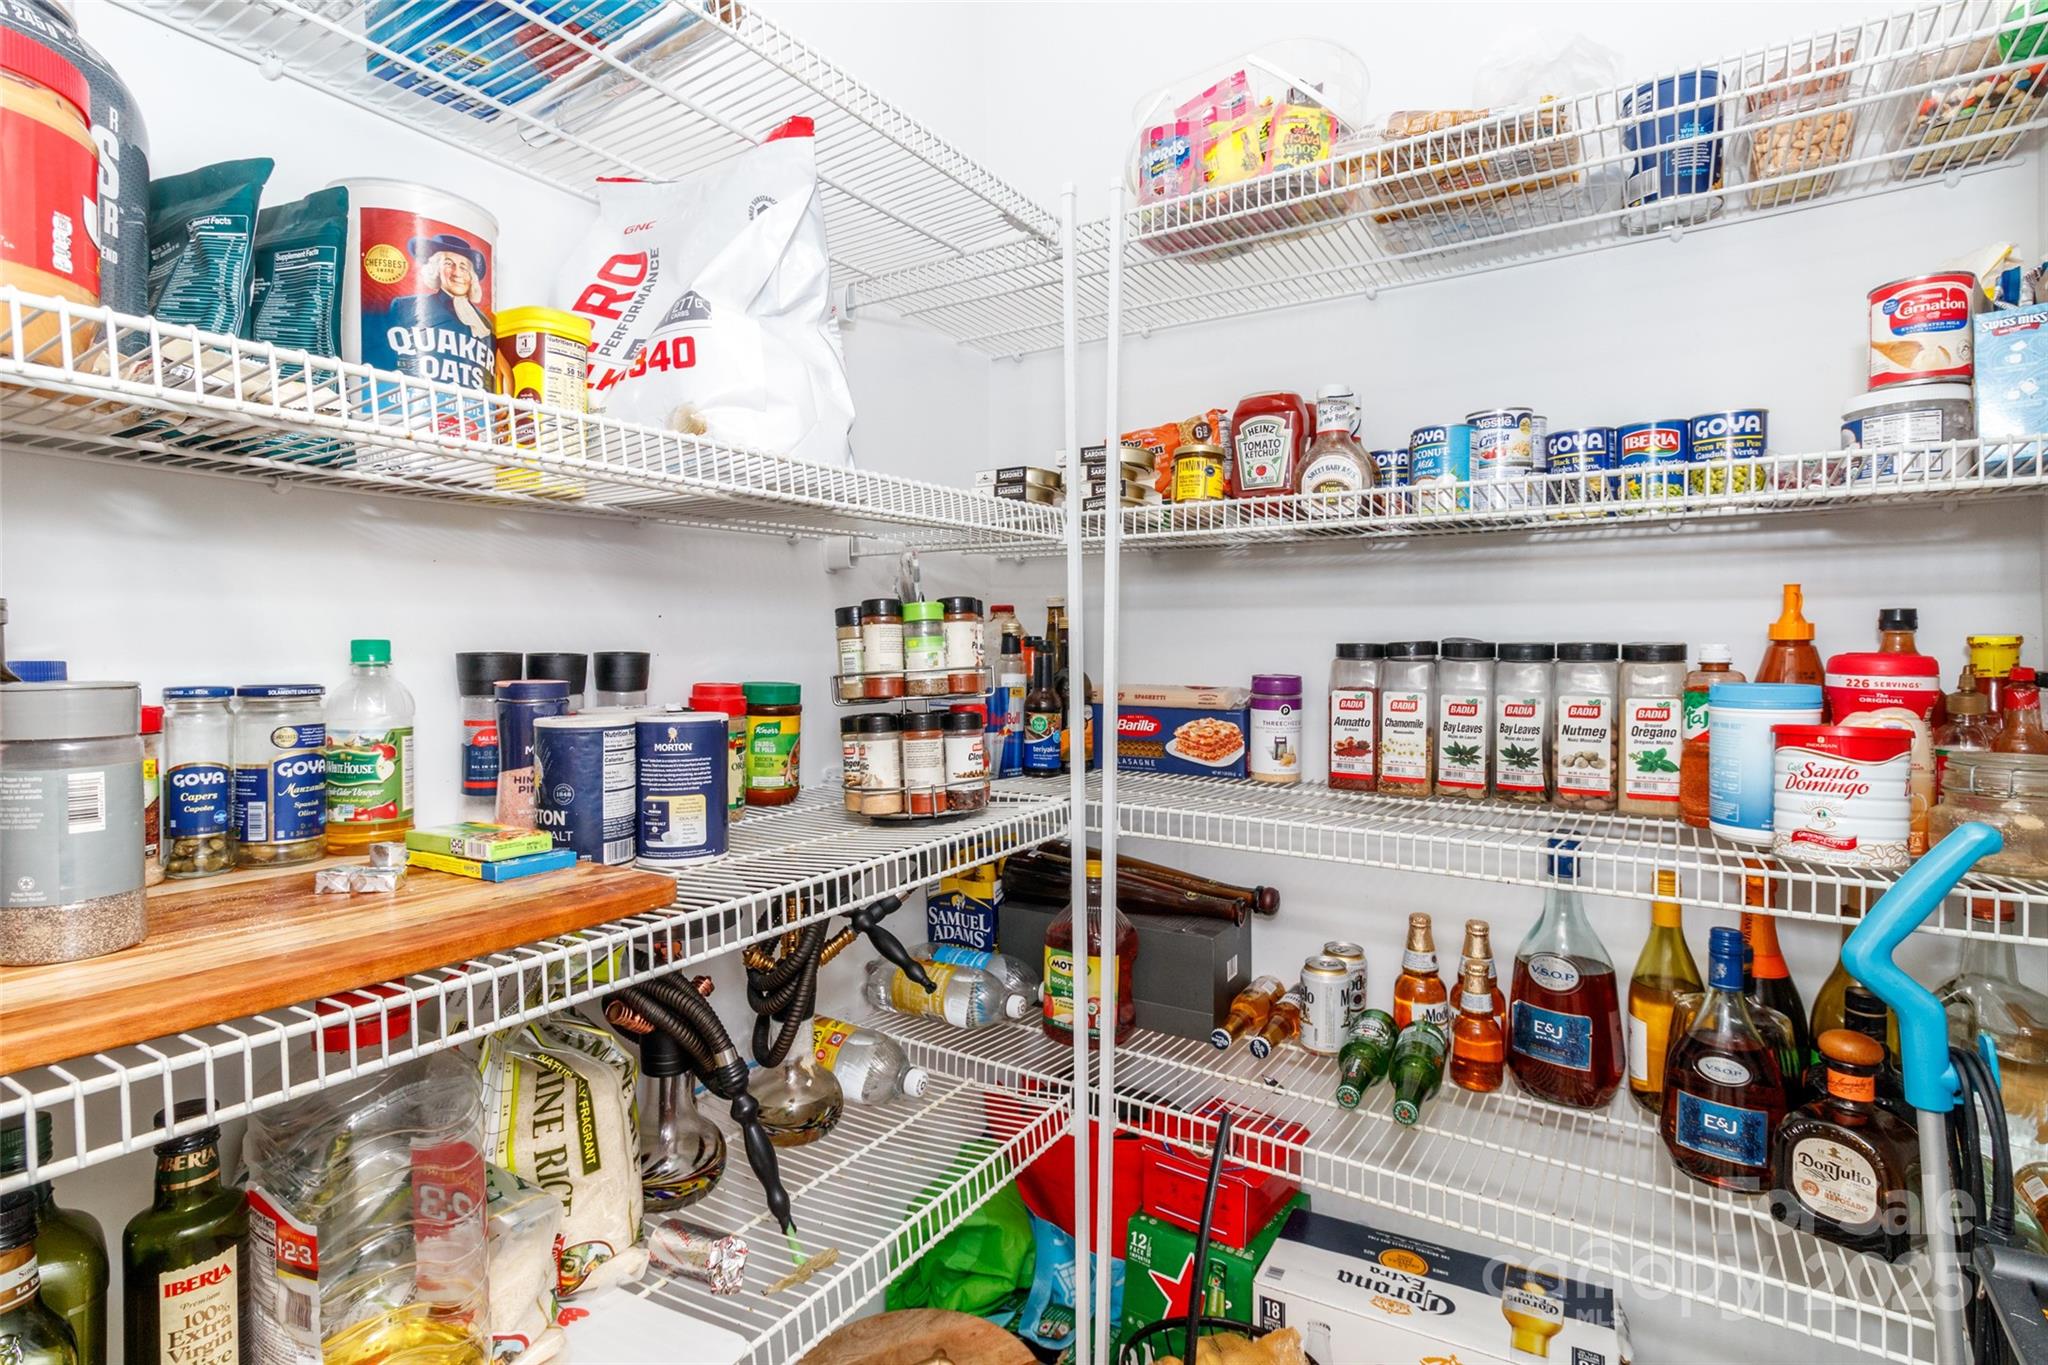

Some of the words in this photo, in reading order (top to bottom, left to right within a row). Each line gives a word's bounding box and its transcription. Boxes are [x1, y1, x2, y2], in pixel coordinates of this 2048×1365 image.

[1284, 134, 1320, 146] PATCH
[624, 220, 657, 235] GNC
[365, 257, 407, 270] CHEFSBEST
[599, 247, 661, 358] PERFORMANCE
[1894, 298, 1968, 320] Carnation
[386, 325, 497, 378] QUAKER
[421, 354, 486, 390] OATS
[1247, 424, 1276, 437] HEINZ
[1694, 414, 1762, 439] GOYA
[1243, 438, 1281, 451] TOMATO
[1411, 428, 1446, 447] GOYA
[1548, 432, 1604, 456] GOYA
[1623, 433, 1679, 450] IBERIA
[1244, 448, 1280, 460] KETCHUP
[999, 471, 1025, 480] SARDINES
[997, 485, 1024, 495] SARDINES
[1845, 678, 1871, 689] 226
[1134, 693, 1167, 702] SPAGHETTI
[1340, 700, 1364, 709] BADIA
[1858, 696, 1905, 705] ORIGINAL
[1391, 701, 1416, 710] BADIA
[1449, 705, 1476, 714] BADIA
[1506, 706, 1534, 716] BADIA
[1569, 707, 1599, 717] BADIA
[1637, 708, 1669, 719] BADIA
[1117, 719, 1158, 733] Barilla
[1262, 719, 1282, 728] THREE
[1334, 716, 1371, 728] Annatto
[1384, 717, 1424, 729] Chamomile
[1442, 721, 1456, 734] Bay
[1456, 722, 1483, 734] Leaves
[1499, 722, 1513, 736] Bay
[1513, 723, 1541, 735] Leaves
[604, 730, 628, 739] Nutrition
[1561, 724, 1608, 740] Nutmeg
[1631, 726, 1678, 740] Oregano
[653, 742, 694, 753] MORTON
[1032, 745, 1055, 755] teriyaki
[277, 758, 327, 778] GOYA
[344, 761, 375, 775] HOUSE
[1800, 761, 1861, 780] Santo
[173, 770, 227, 788] GOYA
[1784, 772, 1871, 800] Domingo
[180, 790, 218, 804] Capers
[352, 787, 385, 797] Vinegar
[293, 799, 320, 809] Spanish
[297, 809, 318, 818] Olives
[928, 907, 992, 933] SAMUEL
[933, 924, 988, 949] ADAMS
[1534, 1019, 1563, 1040] E&J
[1703, 1112, 1738, 1135] E&J
[579, 1100, 597, 1165] FRAGRANT
[1798, 1151, 1834, 1176] Don
[1826, 1160, 1872, 1186] Julio
[1824, 1191, 1869, 1213] REPOSADO
[1130, 1230, 1148, 1248] 12
[163, 1262, 234, 1300] IBERIA
[1368, 1264, 1426, 1291] Extra
[1336, 1268, 1457, 1317] Corona
[1264, 1299, 1281, 1320] 18
[1505, 1293, 1561, 1317] Corona
[183, 1302, 231, 1330] 100%
[168, 1314, 233, 1350] Extra
[167, 1330, 233, 1364] Virgin
